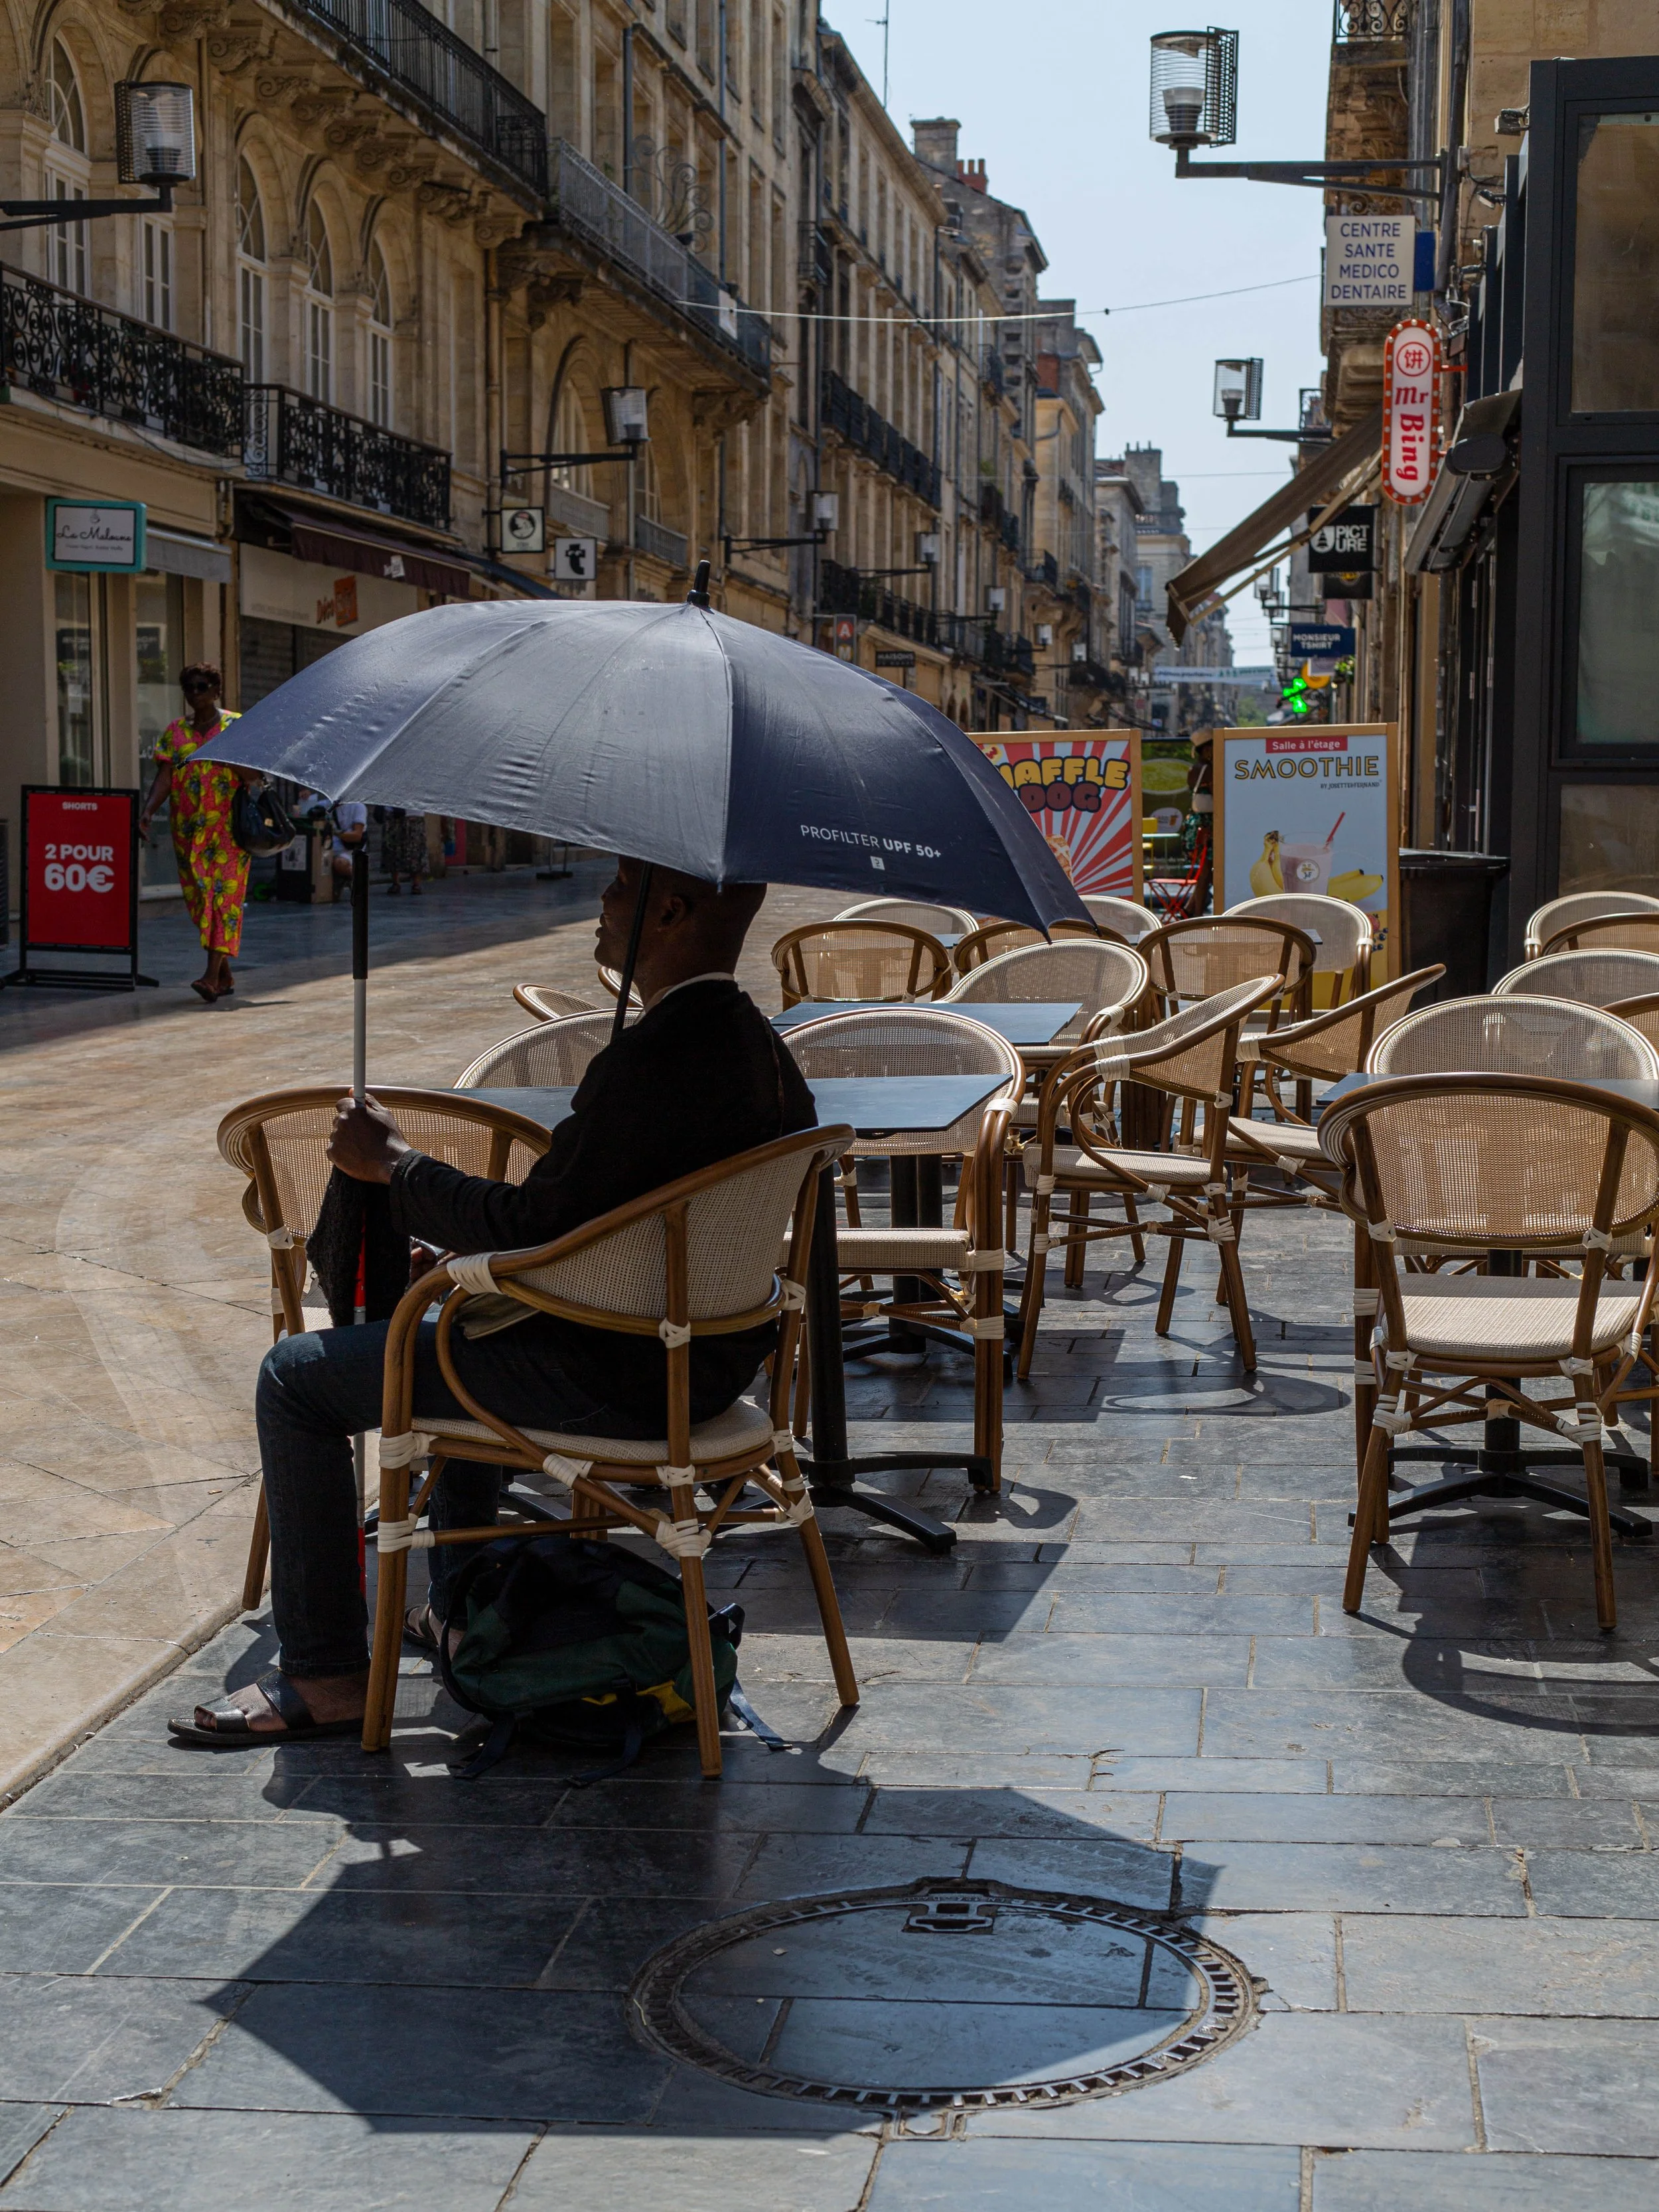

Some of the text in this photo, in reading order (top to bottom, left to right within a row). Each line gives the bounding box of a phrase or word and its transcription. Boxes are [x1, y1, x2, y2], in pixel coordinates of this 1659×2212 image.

[1340, 222, 1402, 238] CENTRE
[1344, 244, 1395, 258] SANTE
[1339, 264, 1400, 279] MEDICO
[1331, 285, 1407, 299] DENTAIRE
[1396, 413, 1425, 481] Bing
[1335, 524, 1370, 538] PICT
[1335, 538, 1367, 552] URE
[840, 623, 851, 637] A
[1301, 641, 1333, 650] TSHIRT
[1272, 739, 1340, 751] Salle à l'étage
[1234, 755, 1379, 780] SMOOTHIE
[1018, 780, 1102, 813] DOG
[62, 801, 98, 811] SHORTS
[800, 824, 942, 858] PROFILTER UPF 50+
[45, 844, 113, 861] 2 POUR
[44, 863, 114, 893] 60€
